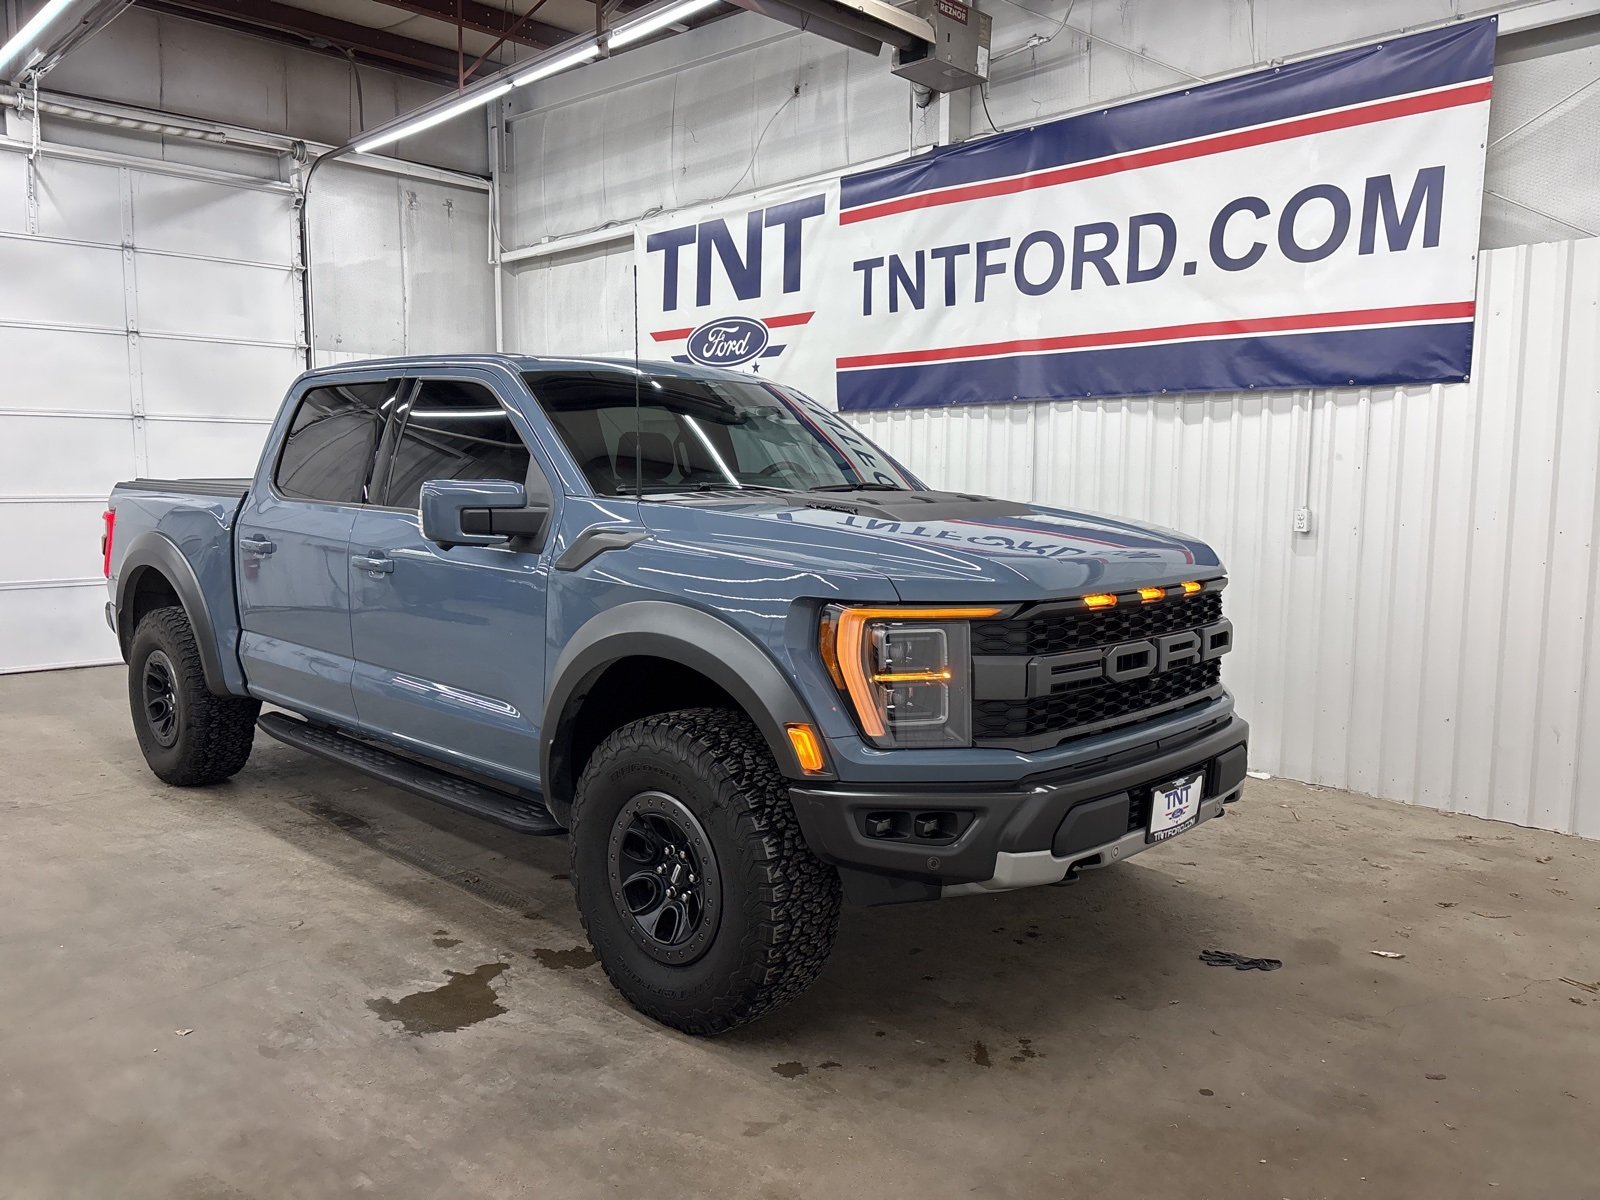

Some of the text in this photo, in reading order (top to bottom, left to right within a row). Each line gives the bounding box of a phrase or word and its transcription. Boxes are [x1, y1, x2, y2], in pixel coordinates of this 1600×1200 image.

[940, 3, 966, 21] REZNOR
[647, 193, 826, 312] TNT
[853, 165, 1446, 317] TNTFORD.COM
[702, 326, 751, 358] Ford
[1029, 616, 1234, 698] FORD
[1165, 785, 1191, 810] TNT
